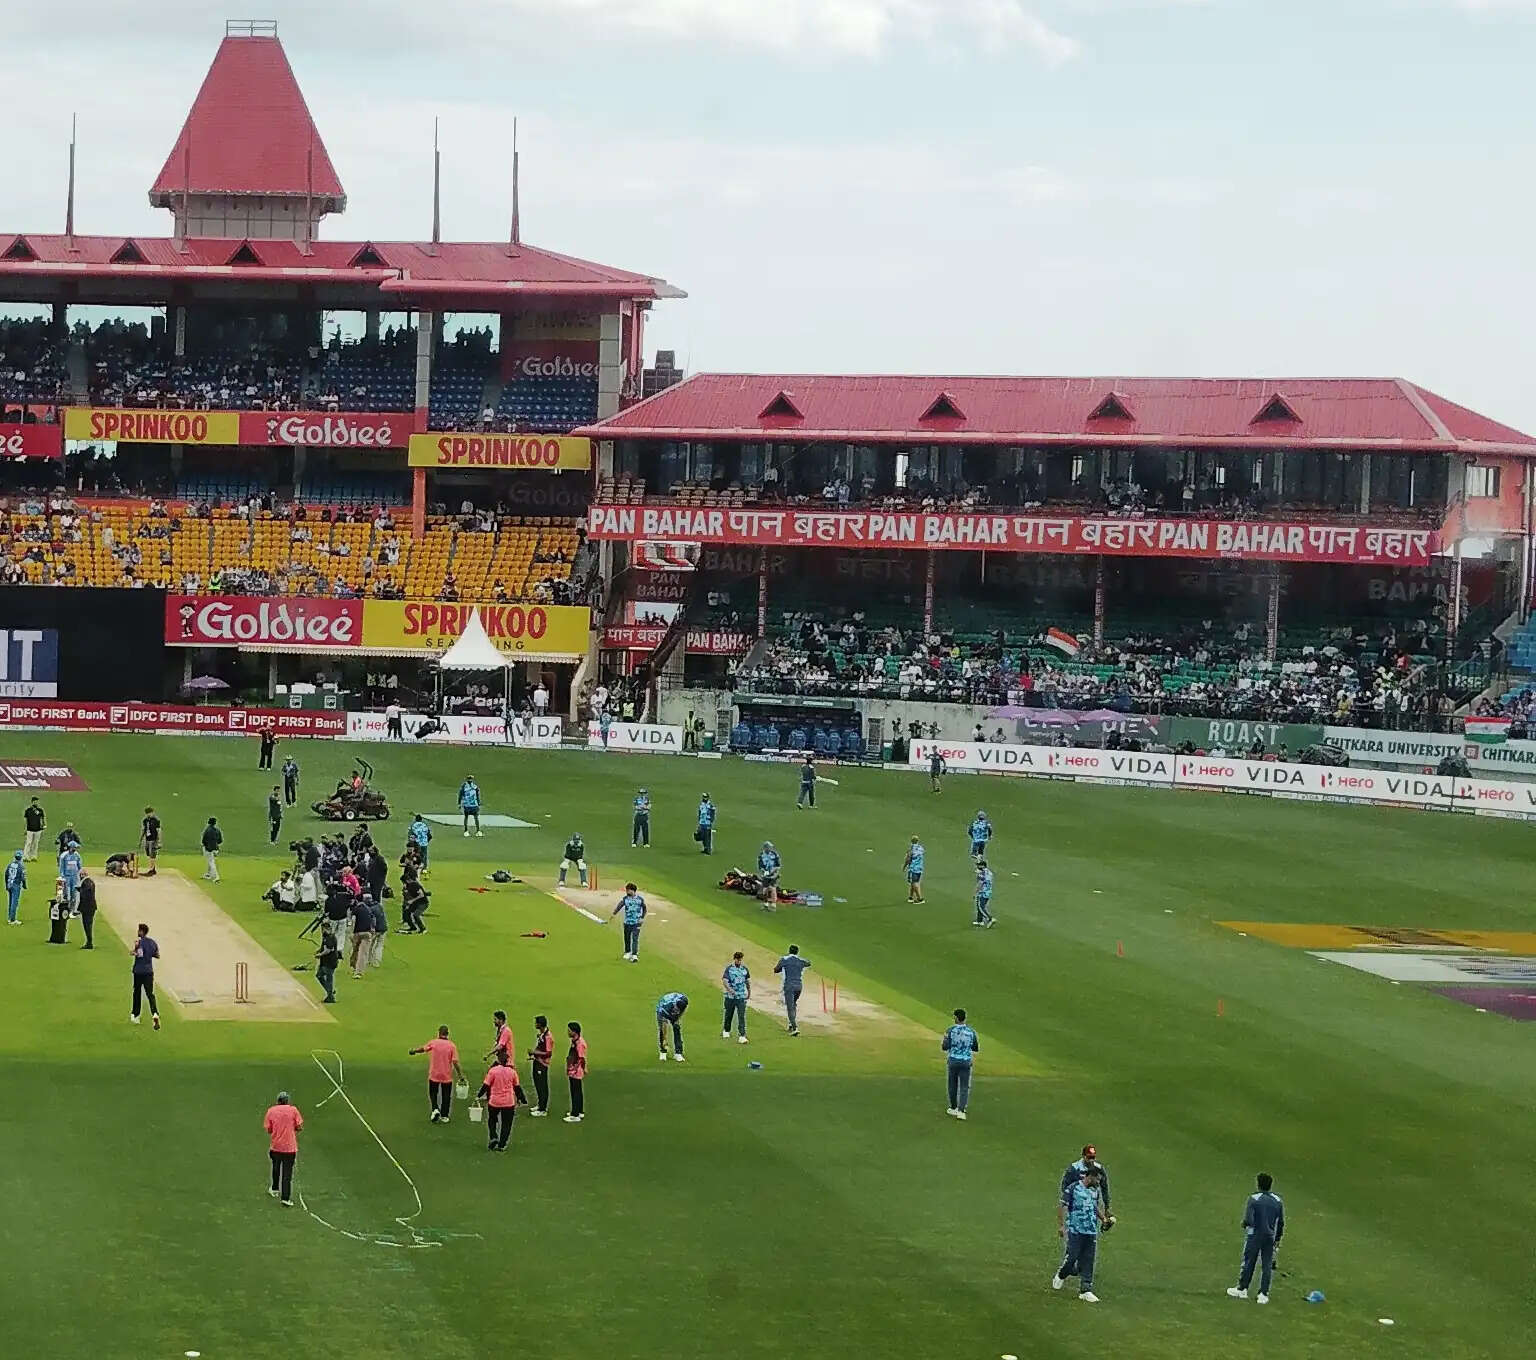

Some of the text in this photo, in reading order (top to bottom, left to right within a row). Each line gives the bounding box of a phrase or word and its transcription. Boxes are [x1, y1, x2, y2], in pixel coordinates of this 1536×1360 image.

[89, 413, 207, 441] SPRINKOO
[438, 437, 560, 466] SPRINKOO
[590, 509, 723, 536] PAN BAHAR
[729, 512, 866, 540] पान बहार
[868, 514, 1008, 544] PAN BAHAR
[1014, 518, 1157, 548] पान बहार
[1159, 522, 1304, 554] PAN BAHAR
[1308, 526, 1431, 559] पान बहार
[426, 638, 525, 650] SEAING
[687, 632, 709, 648] PAN
[12, 708, 106, 720] IDFC FIRST Bank
[130, 711, 224, 724] IDFC FIRST Bank
[248, 715, 344, 729] IDFC FIRST Bank
[366, 721, 388, 729] Her
[1208, 721, 1279, 745] ROAST
[628, 730, 675, 745] VIDA
[942, 749, 966, 759] ero
[1325, 737, 1462, 757] CHITKARA UNIVERSITY
[978, 749, 1033, 765] VIDA
[1065, 756, 1099, 767] Hero
[1111, 756, 1167, 775] VIDA
[1199, 766, 1234, 777] Hero
[1247, 767, 1304, 785] VIDA
[1338, 776, 1374, 789] Hero
[1387, 779, 1444, 797] VIDA
[1478, 788, 1515, 801] Hero
